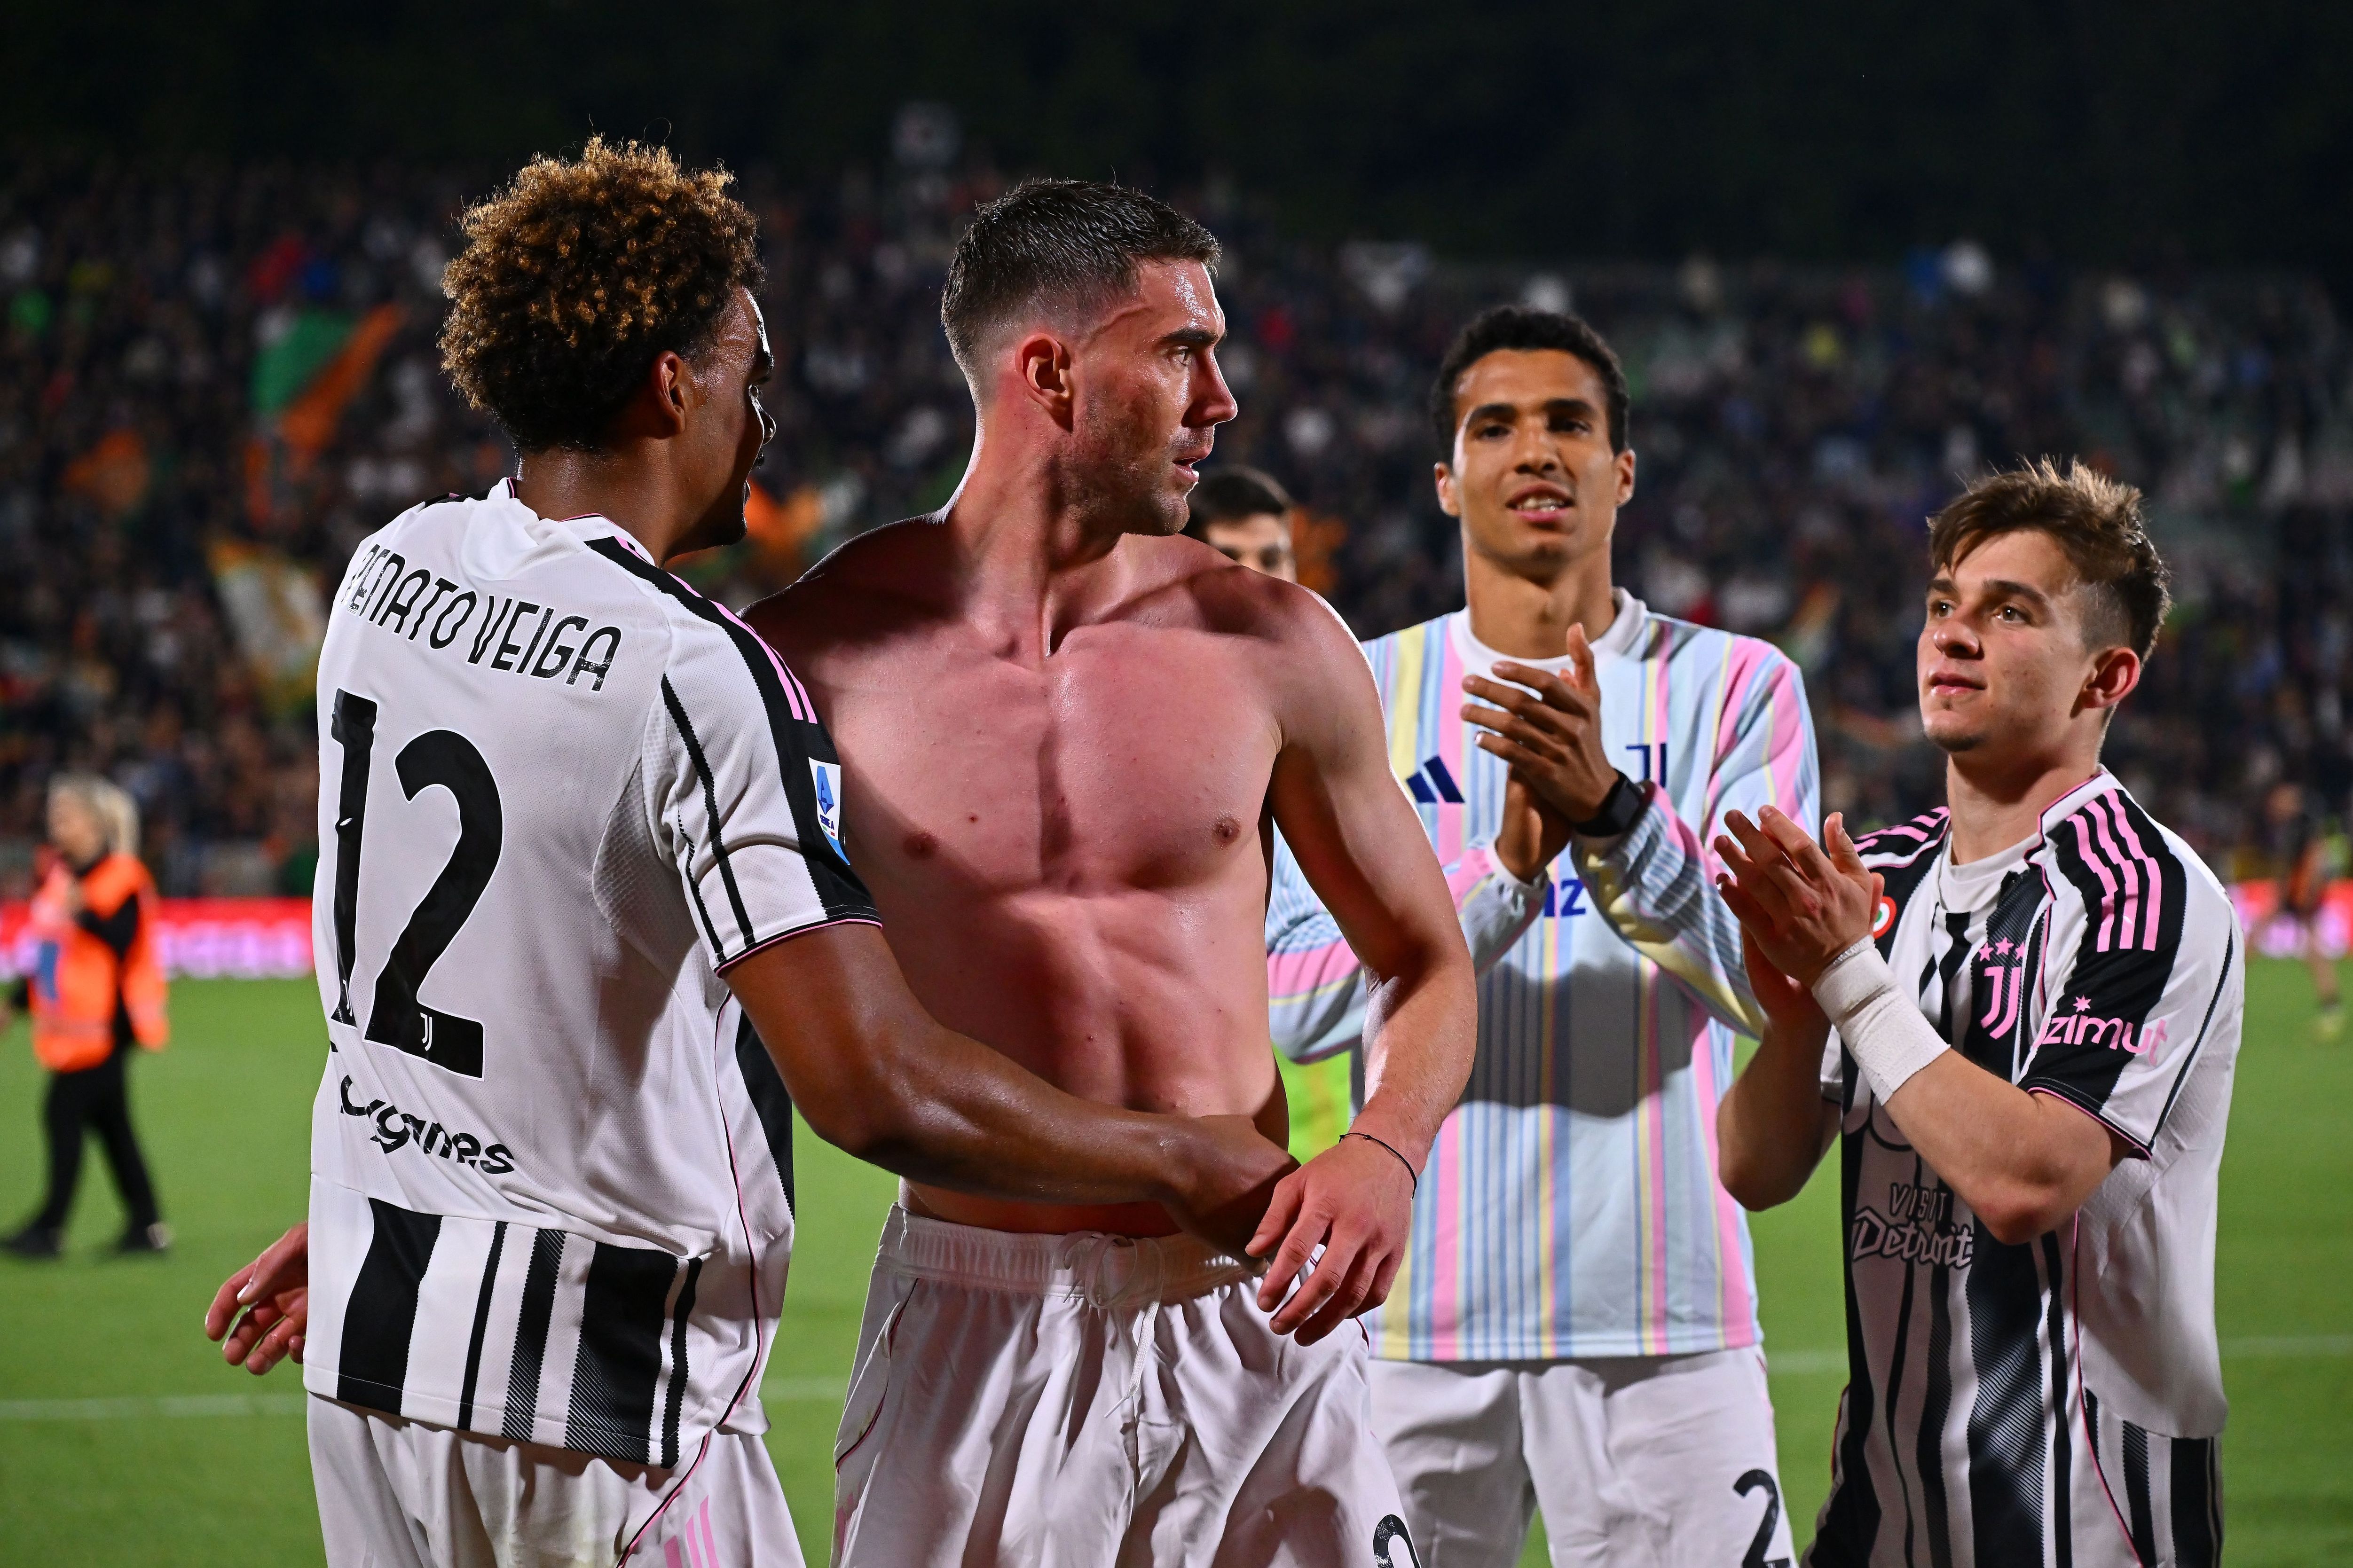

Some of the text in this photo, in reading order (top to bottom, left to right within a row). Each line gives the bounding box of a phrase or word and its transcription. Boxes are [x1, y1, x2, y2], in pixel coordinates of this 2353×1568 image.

[467, 595, 622, 691] VEIGA
[331, 688, 503, 1078] 12
[1853, 1208, 1974, 1268] Detroit
[1890, 1183, 1948, 1222] VISIT
